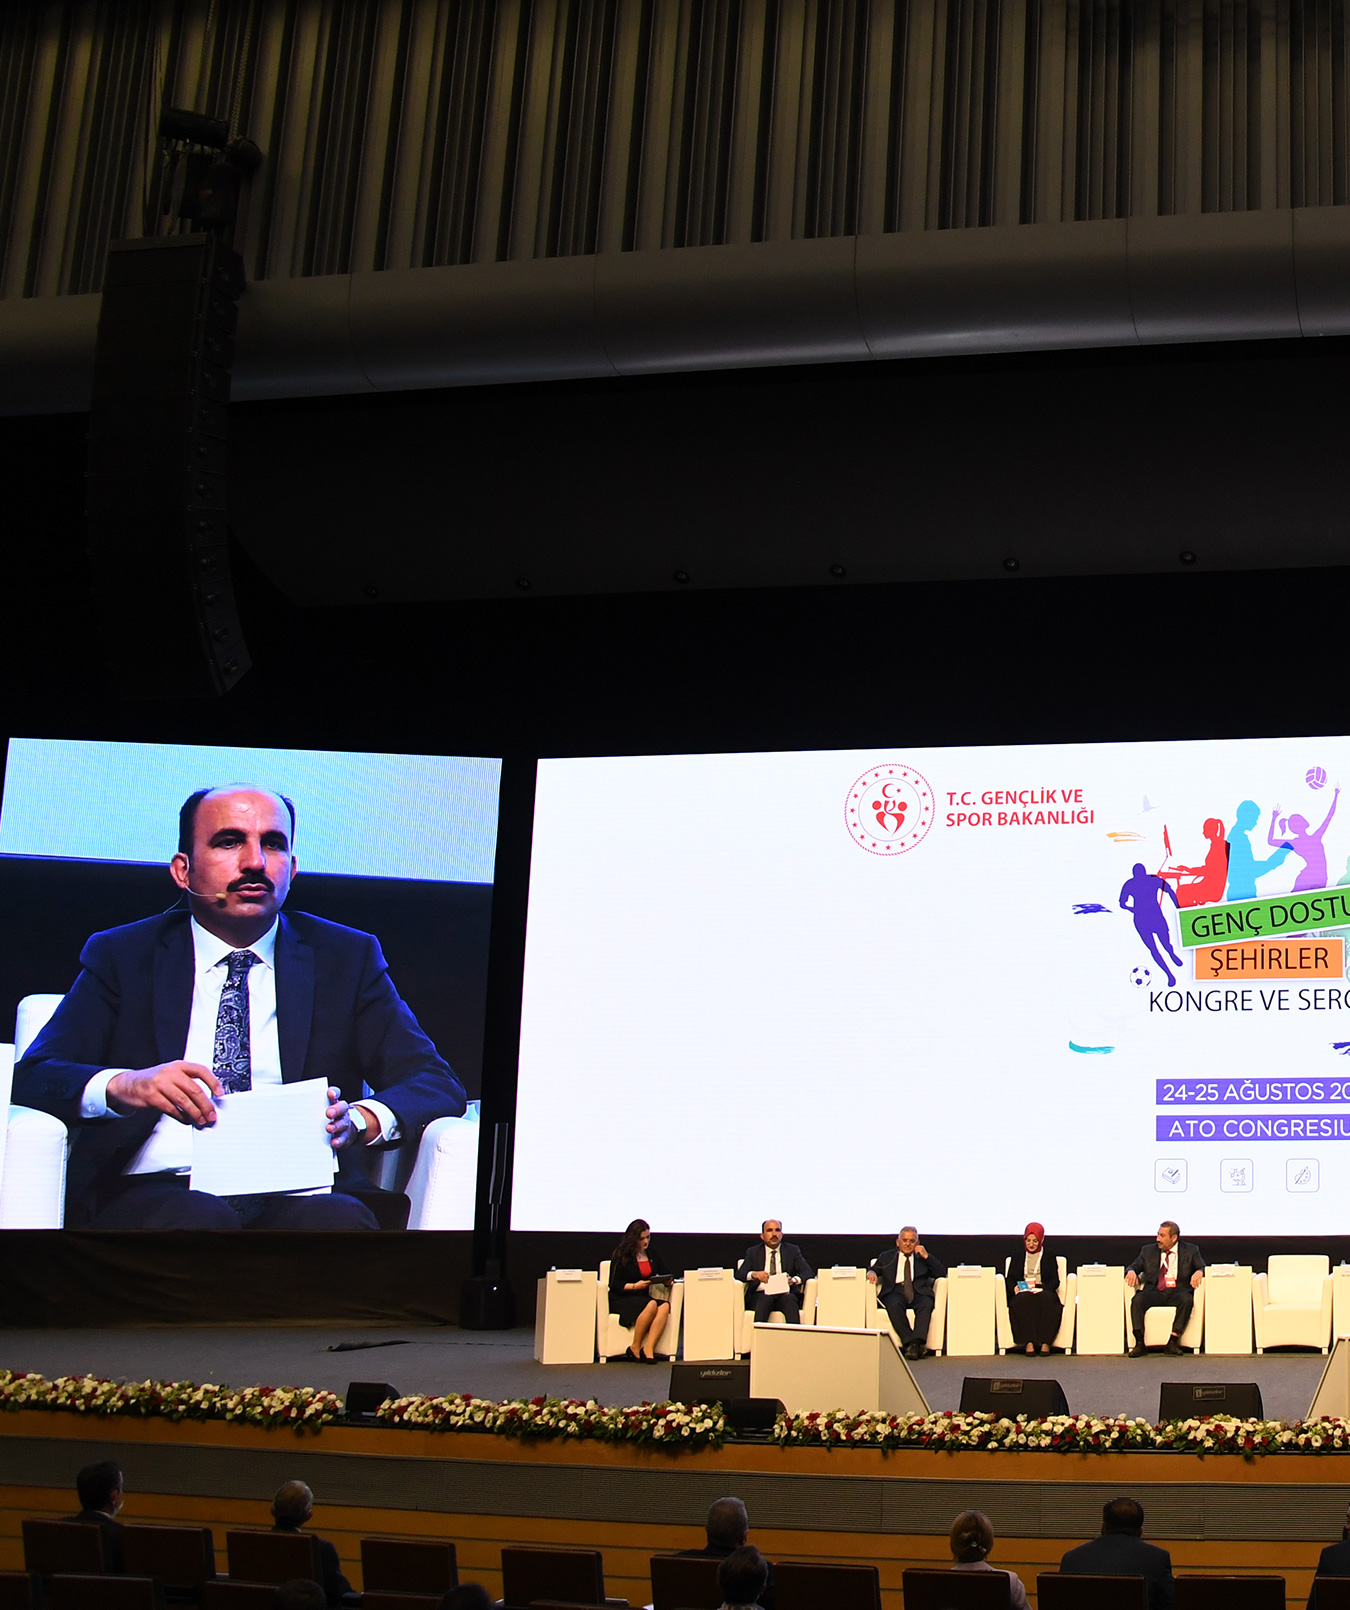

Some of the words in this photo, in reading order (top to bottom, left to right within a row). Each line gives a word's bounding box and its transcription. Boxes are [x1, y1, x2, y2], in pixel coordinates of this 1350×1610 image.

[946, 791, 976, 806] T.C.
[981, 786, 1057, 808] GENÇLİK
[1061, 788, 1083, 803] VE
[946, 811, 992, 827] SPOR
[997, 806, 1094, 826] BAKANLIĞI
[1191, 907, 1263, 937] GENÇ
[1210, 943, 1329, 977] ŞEHİRLER
[1149, 990, 1253, 1012] KONGRE
[1259, 989, 1290, 1011] VE
[1162, 1083, 1219, 1101] 24-25
[1223, 1079, 1325, 1101] AĞUSTOS
[1168, 1120, 1216, 1138] ATO
